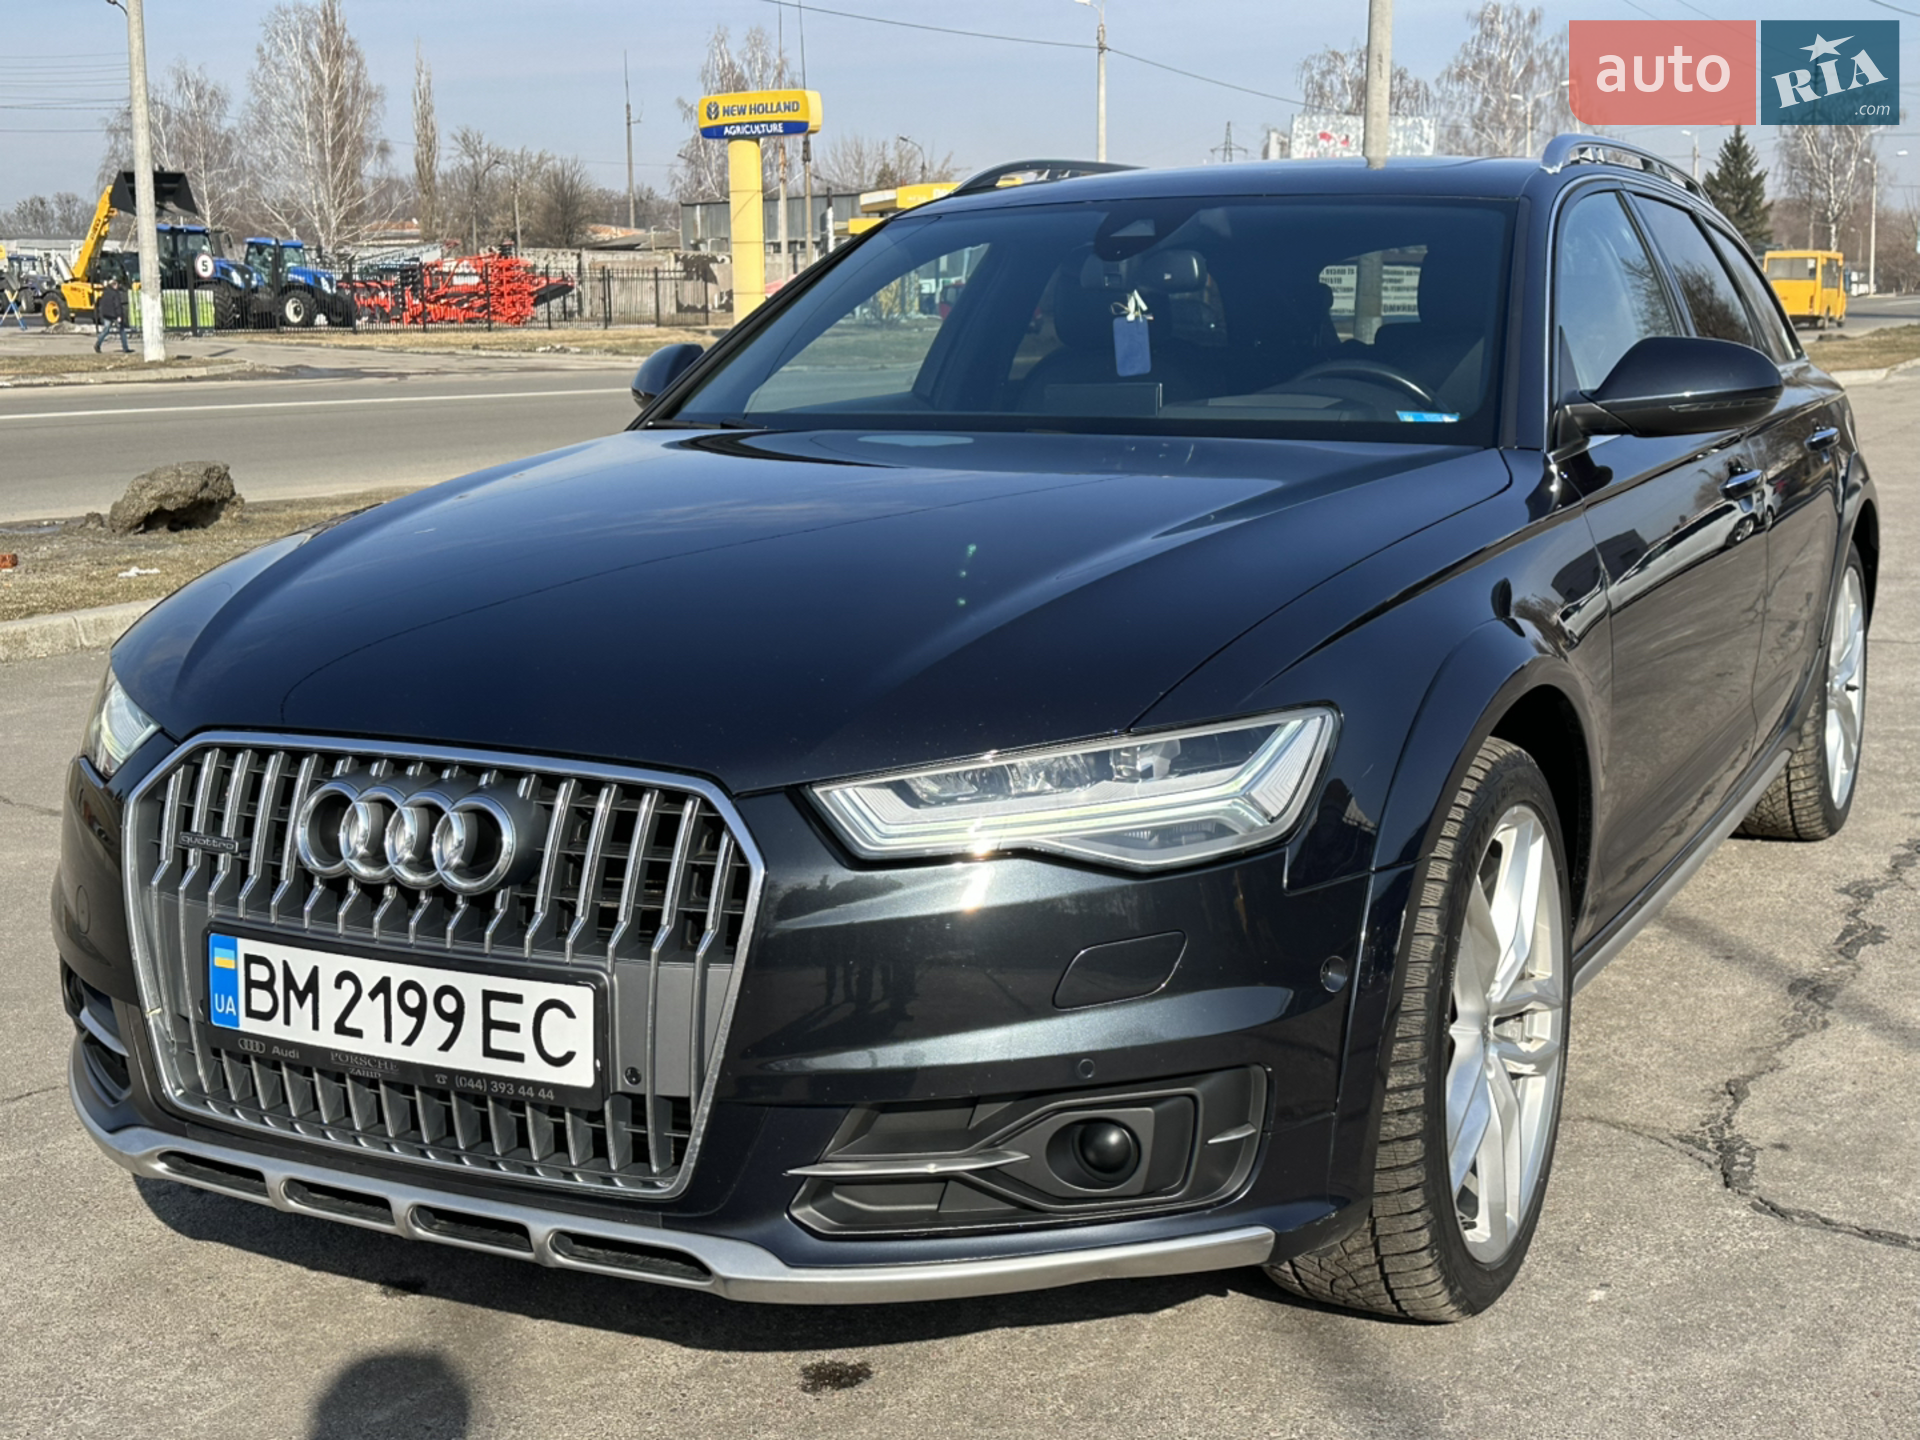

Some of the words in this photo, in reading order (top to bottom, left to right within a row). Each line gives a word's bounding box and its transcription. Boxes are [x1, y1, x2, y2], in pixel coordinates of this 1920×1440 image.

[722, 104, 747, 117] NEW
[749, 101, 800, 115] HOLLAND
[723, 123, 784, 136] AGRICULTURE
[201, 257, 209, 272] 5
[214, 992, 237, 1016] UA
[243, 953, 320, 1031] BM
[333, 969, 466, 1053] 2199
[482, 989, 578, 1068] EC
[271, 1045, 300, 1060] Audi
[330, 1051, 399, 1072] PORSCHE
[455, 1074, 488, 1092] (044)
[490, 1080, 515, 1095] 393
[518, 1085, 535, 1098] 44
[537, 1088, 555, 1101] 44
